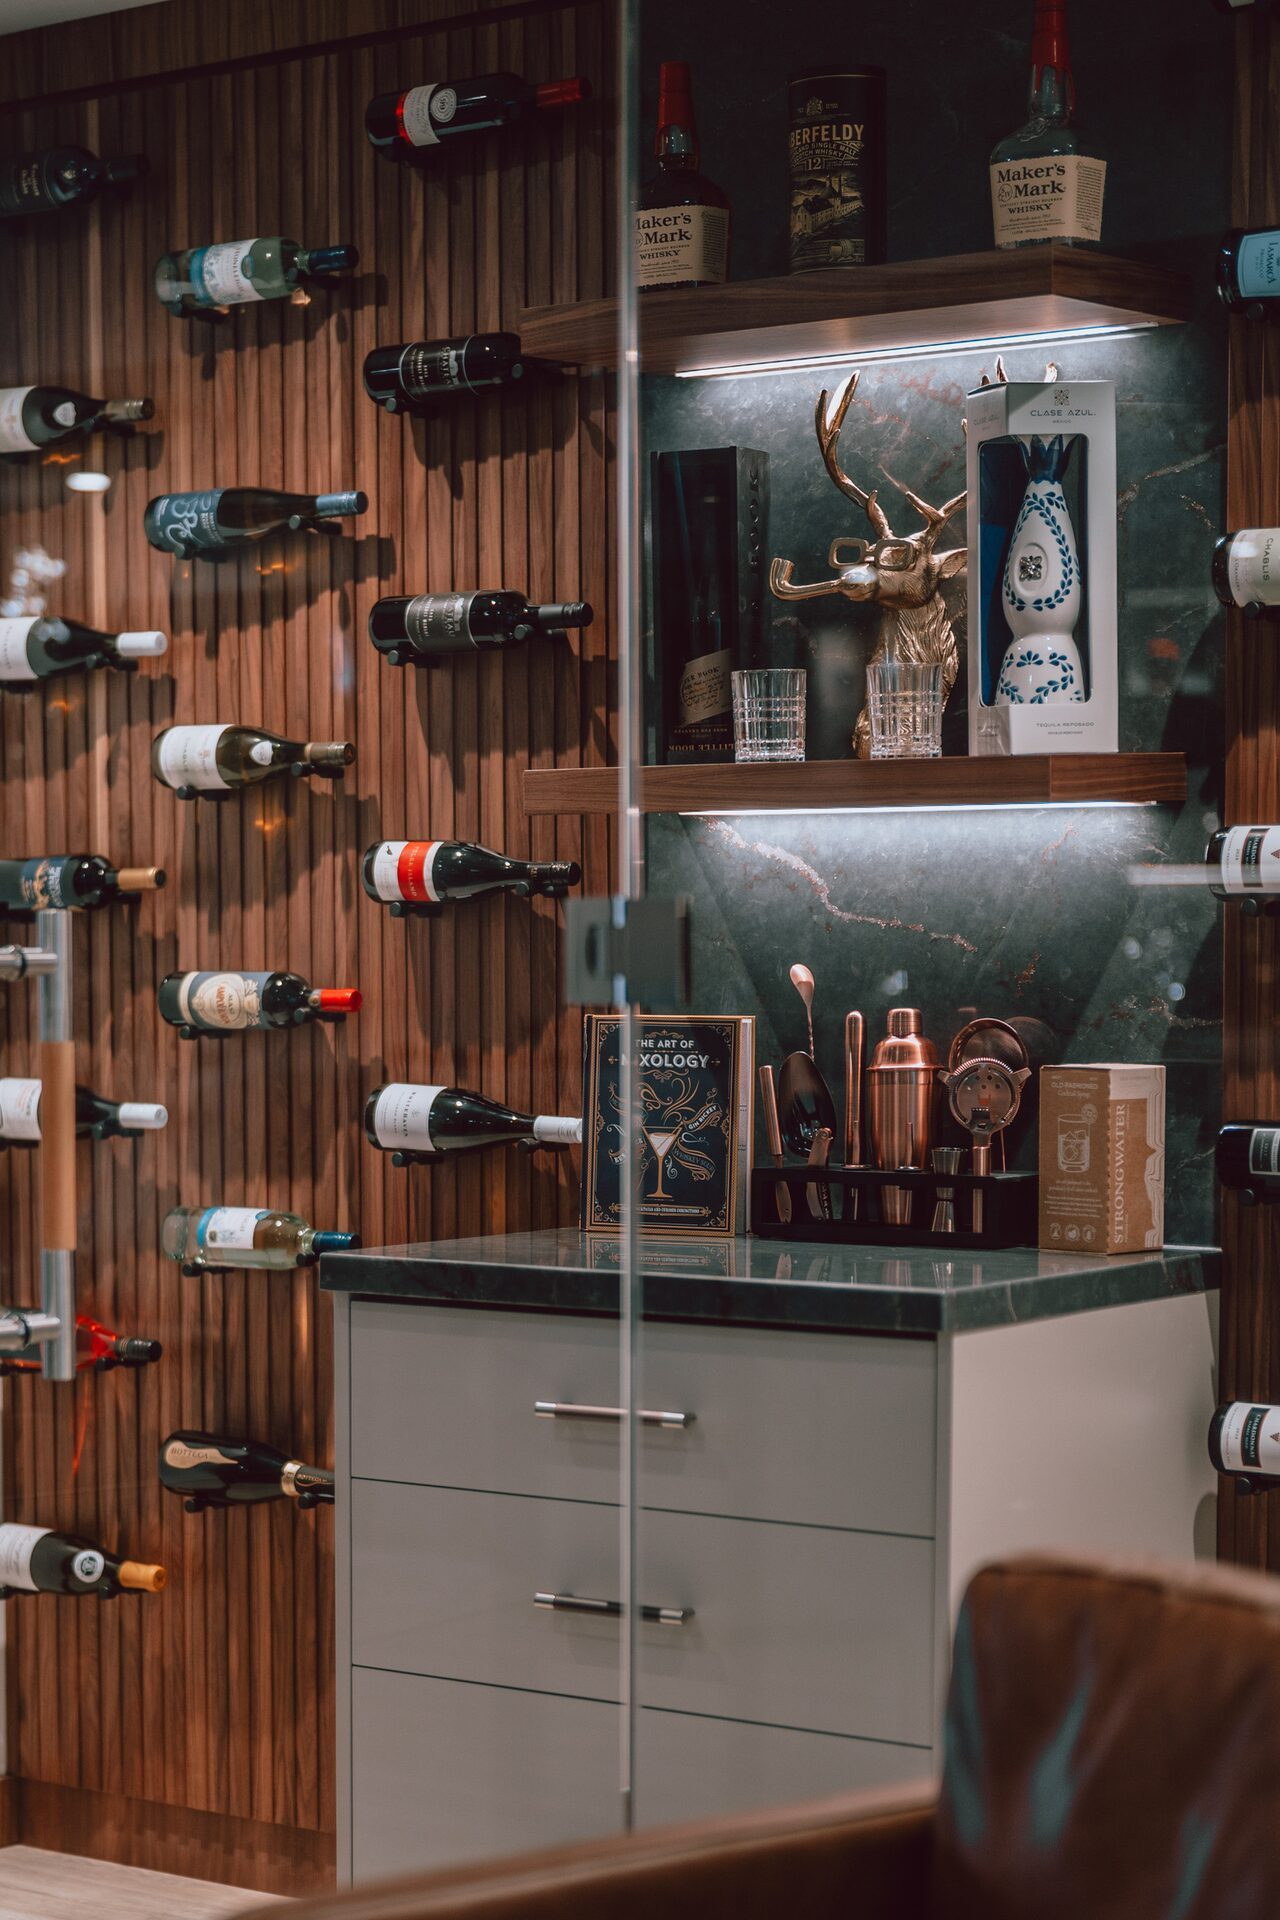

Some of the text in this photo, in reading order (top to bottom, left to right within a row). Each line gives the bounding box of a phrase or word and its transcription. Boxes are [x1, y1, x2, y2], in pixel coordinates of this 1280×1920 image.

[790, 124, 864, 148] BERFELDY
[815, 149, 844, 157] WHISKY
[840, 145, 857, 156] MALT
[807, 157, 821, 170] 12
[996, 163, 1066, 184] Maker's
[1013, 181, 1065, 199] Mark
[1007, 203, 1053, 215] WHISKY
[643, 229, 692, 245] Mark
[640, 249, 681, 260] WHISKY
[1030, 409, 1063, 417] CLASE
[1262, 537, 1274, 581] CHABLIS
[657, 1040, 677, 1048] ART
[680, 1040, 695, 1048] OF
[688, 1105, 718, 1130] GIN RICKEY
[1114, 1104, 1126, 1244] STRONGWATER
[1249, 1414, 1262, 1458] CHARDONNAY
[171, 1447, 209, 1459] BOTTEGA
